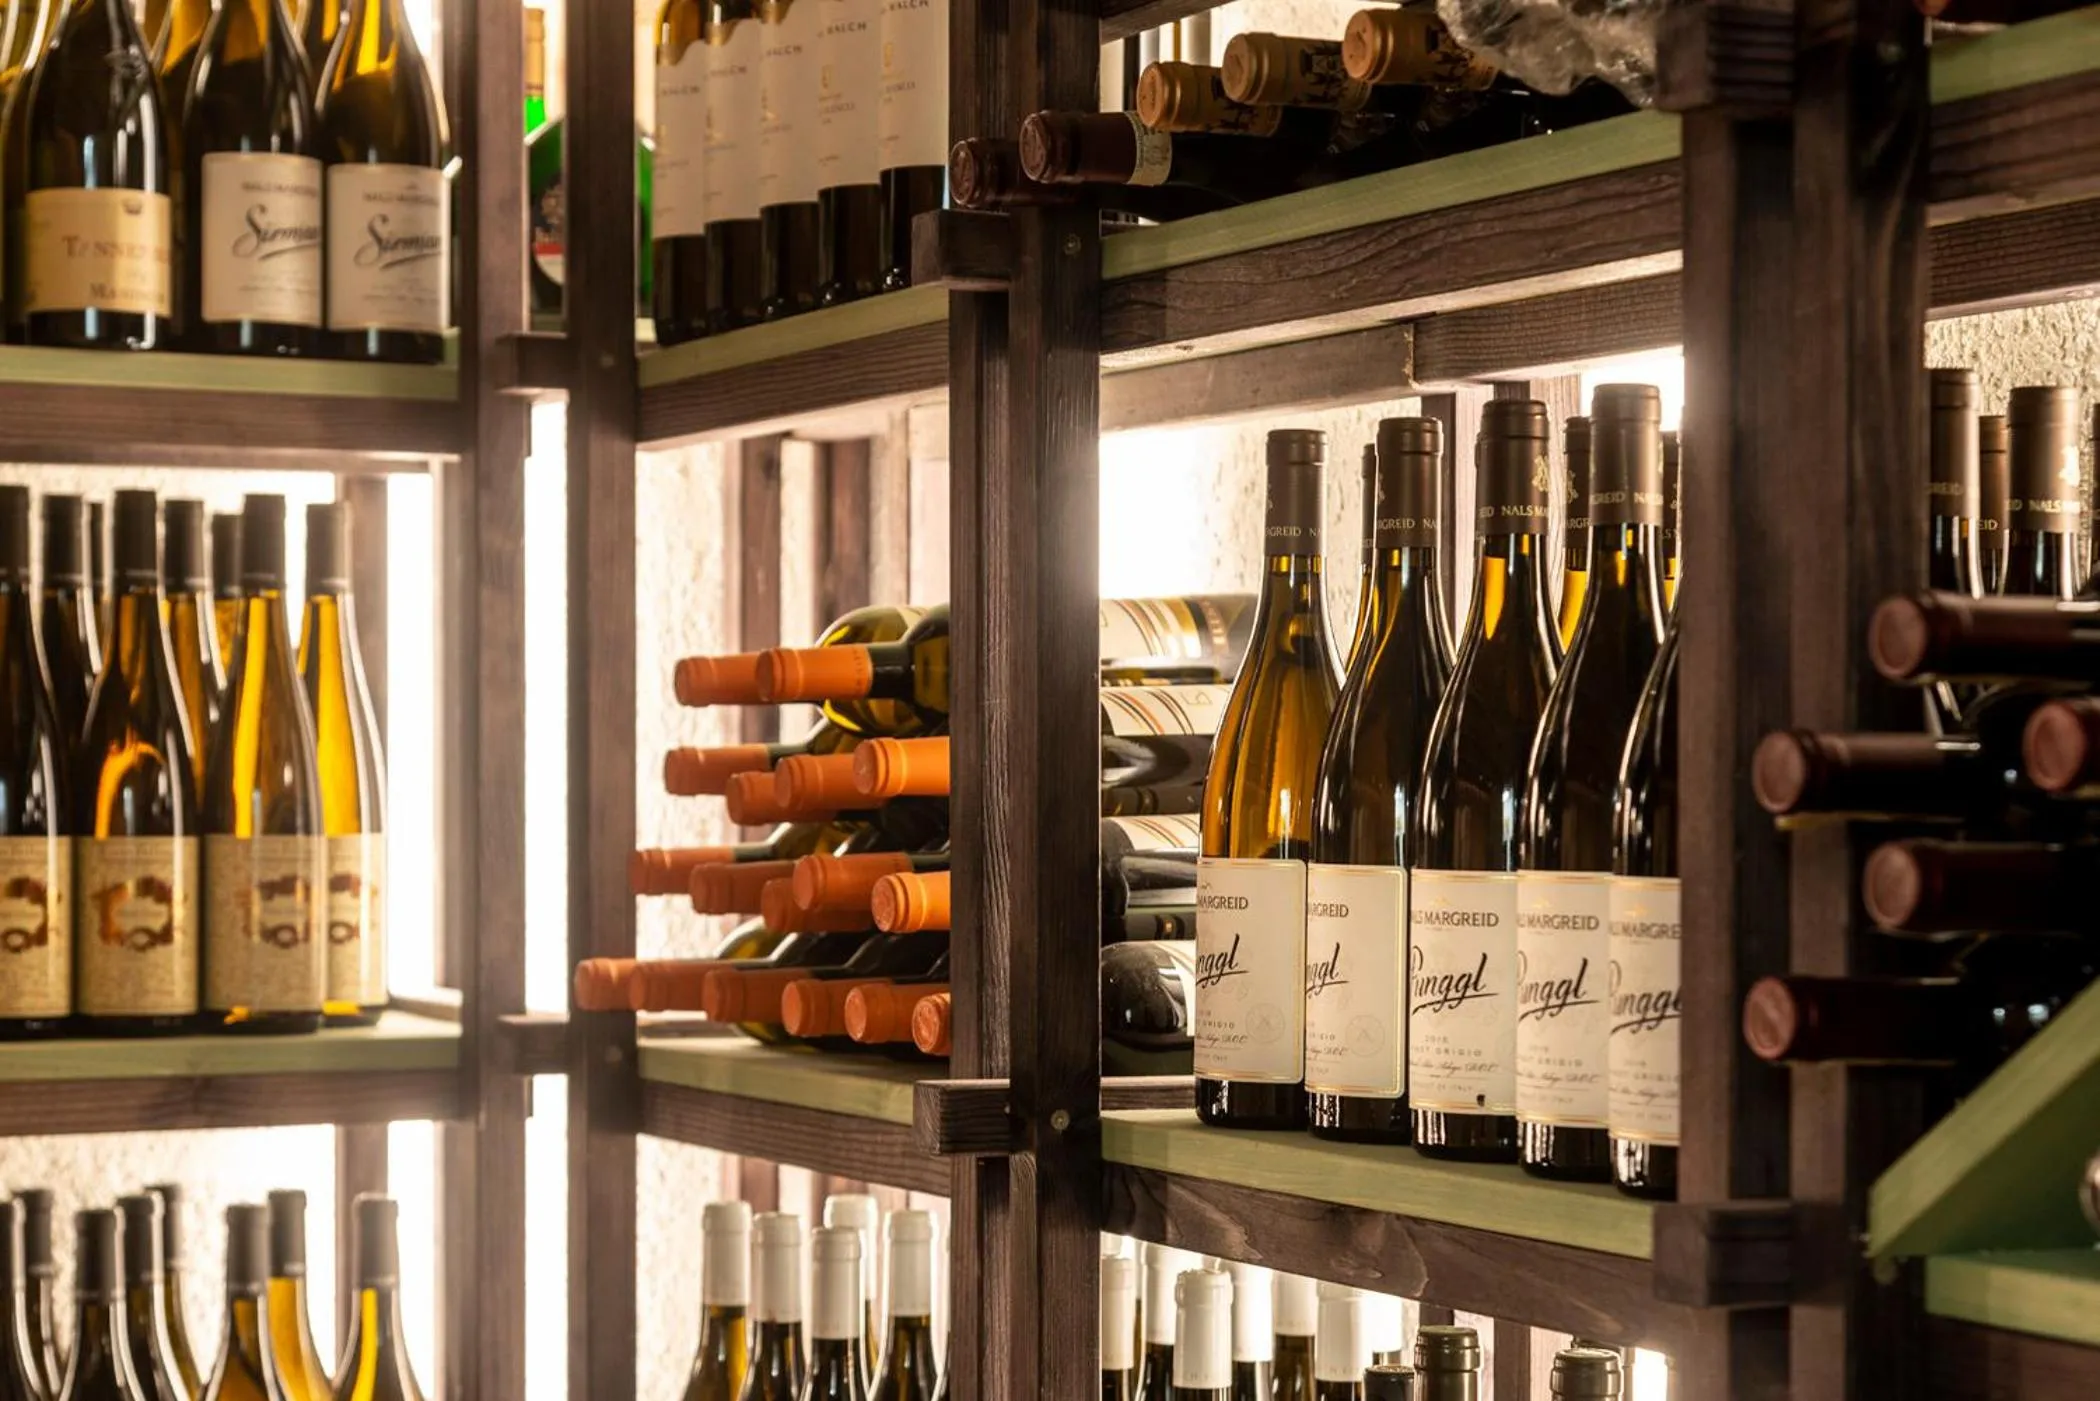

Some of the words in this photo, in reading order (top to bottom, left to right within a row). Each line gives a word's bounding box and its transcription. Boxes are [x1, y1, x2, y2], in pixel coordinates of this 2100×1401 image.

[1502, 505, 1533, 516] NALS
[1424, 911, 1500, 928] MARGREID
[1527, 913, 1600, 931] MARGREID
